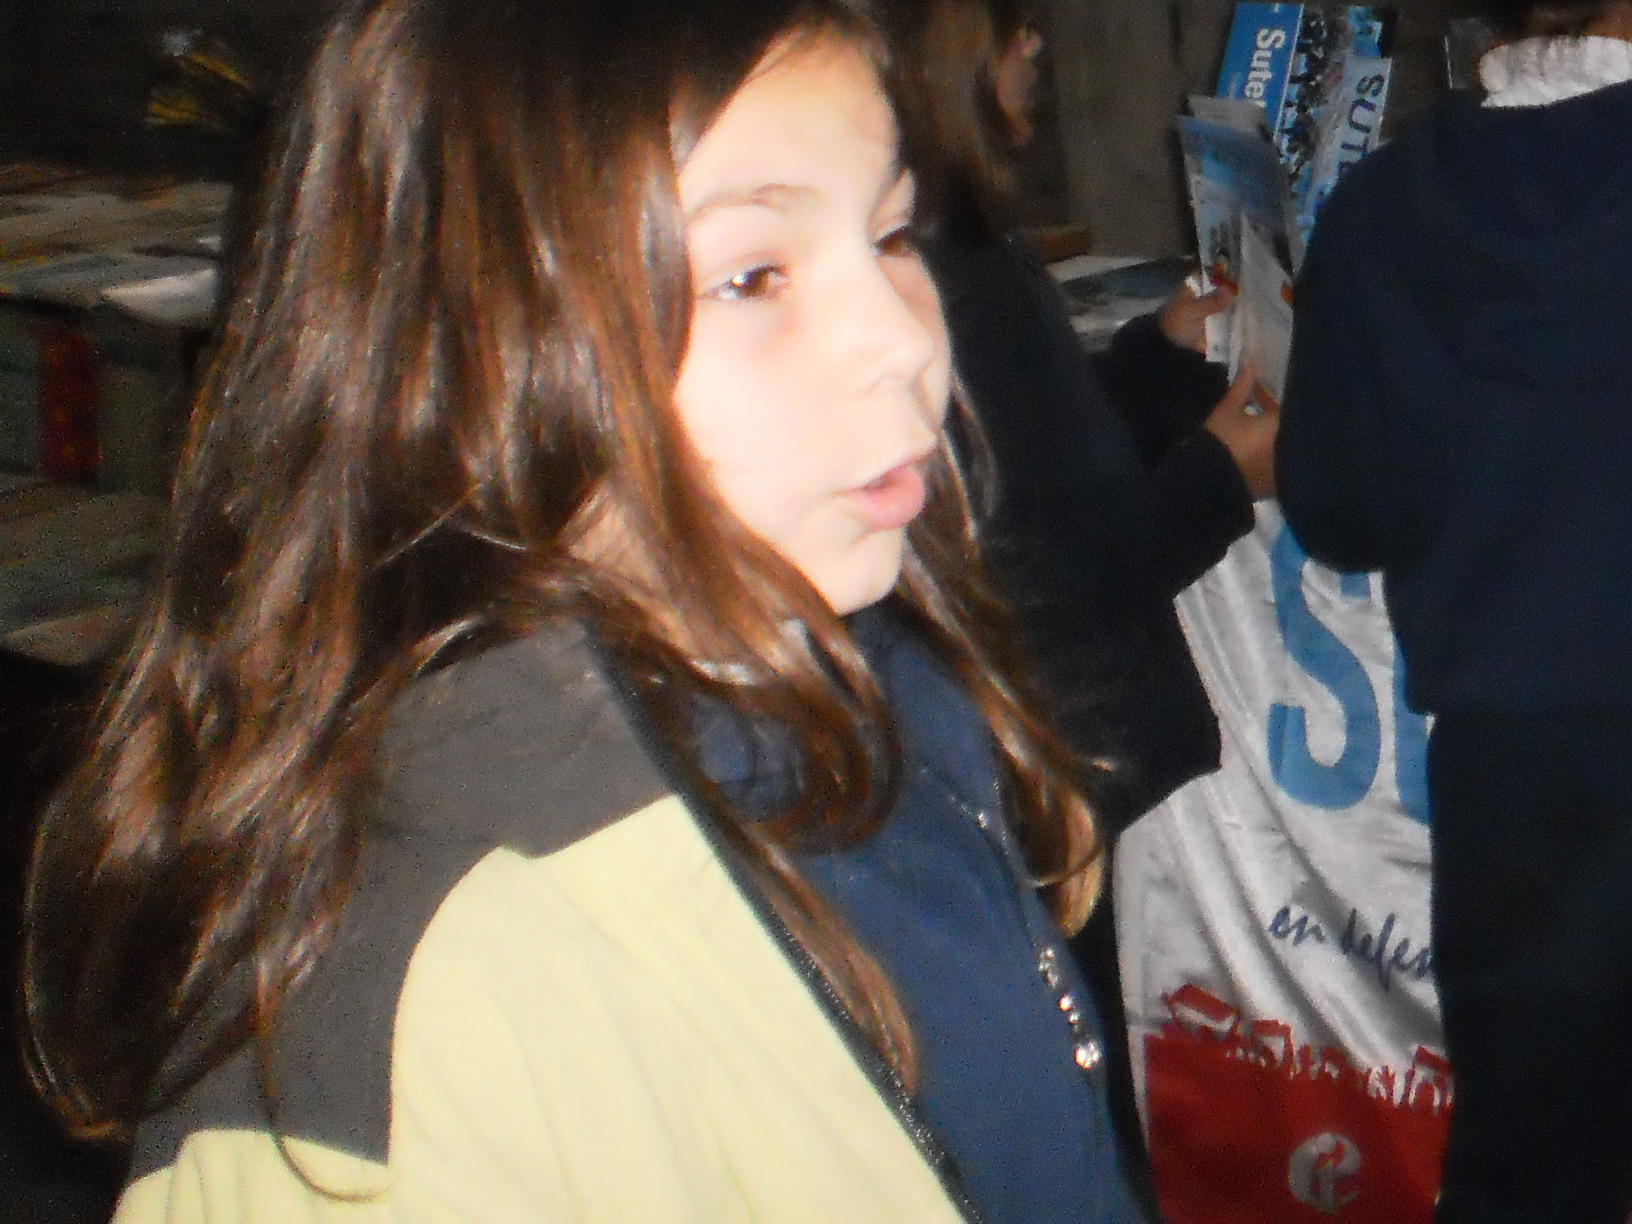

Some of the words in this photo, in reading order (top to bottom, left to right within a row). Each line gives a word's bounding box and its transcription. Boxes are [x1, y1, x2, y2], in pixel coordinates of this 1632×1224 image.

[1243, 27, 1287, 108] Sute
[1338, 73, 1386, 176] SUT
[1267, 905, 1326, 947] en
